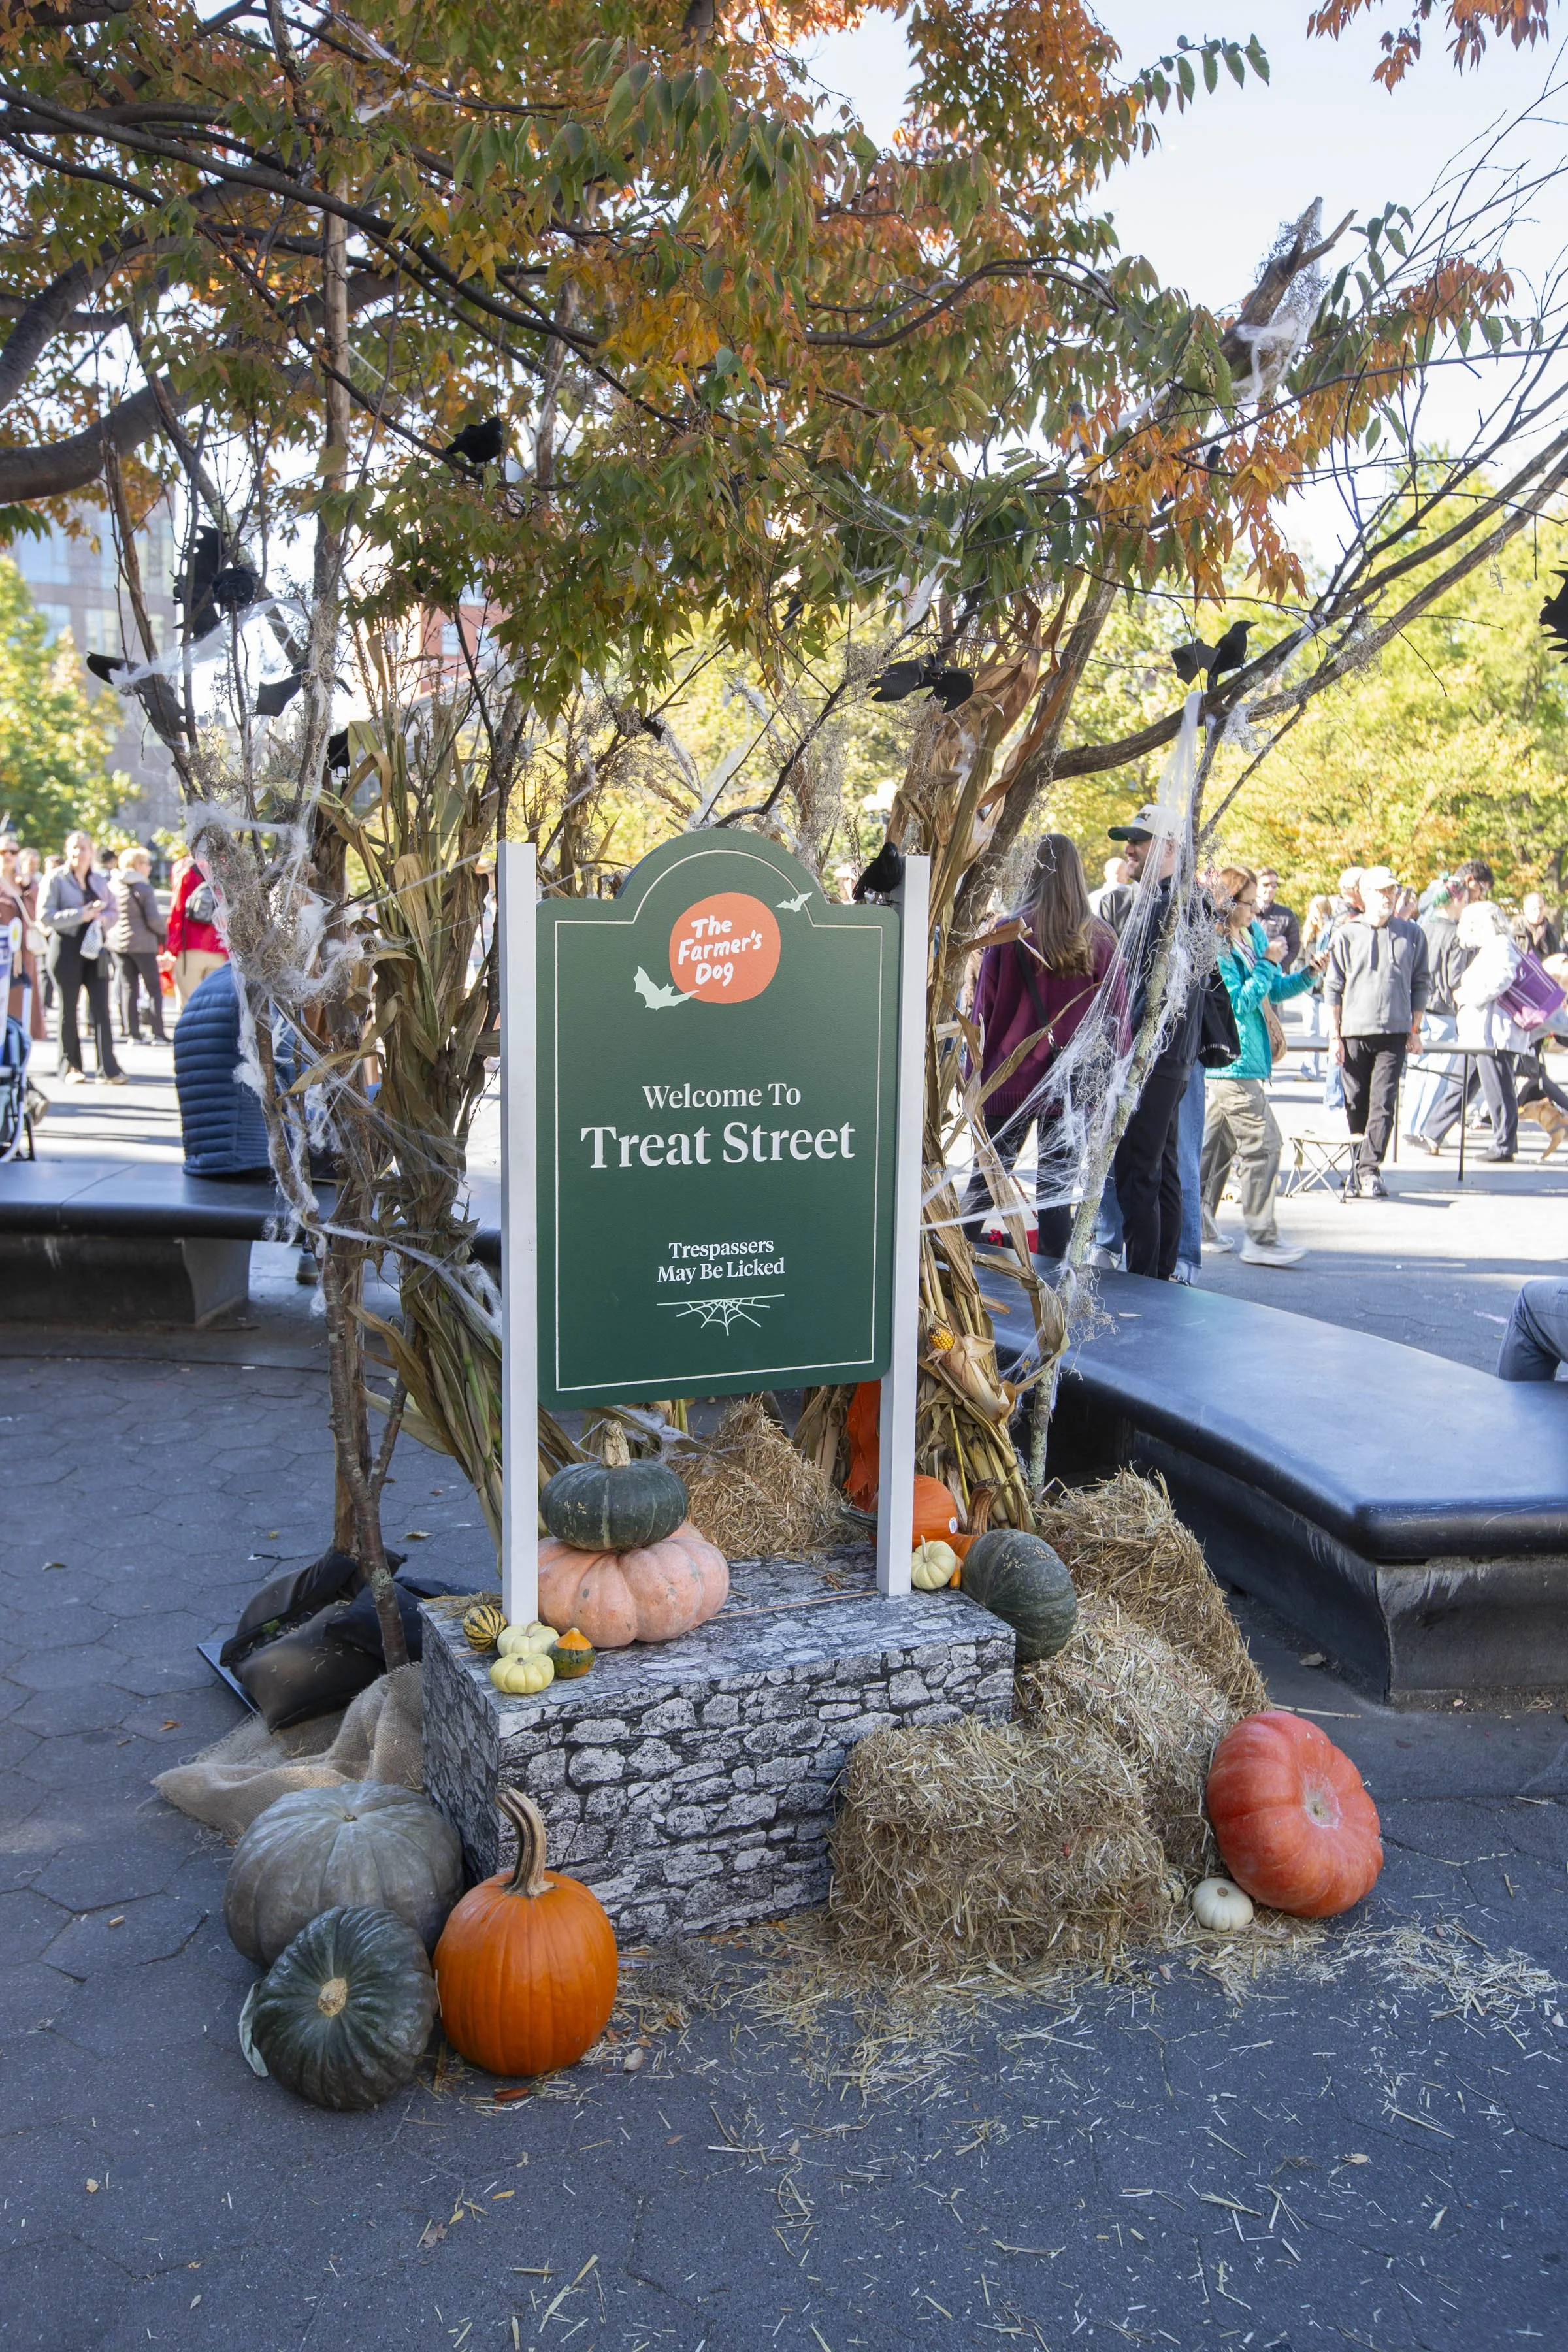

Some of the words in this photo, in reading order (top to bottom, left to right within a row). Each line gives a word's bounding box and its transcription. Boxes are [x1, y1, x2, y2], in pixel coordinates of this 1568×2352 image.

[691, 915, 732, 938] The
[678, 929, 763, 966] Farmer's
[695, 962, 734, 987] Dog
[642, 1083, 762, 1109] Welcome
[768, 1083, 802, 1106] To
[580, 1126, 711, 1169] Treat
[723, 1121, 856, 1164] Street
[668, 1240, 774, 1261] Trespassers
[657, 1265, 697, 1285] May
[700, 1263, 723, 1280] Be
[726, 1256, 785, 1278] Licked
